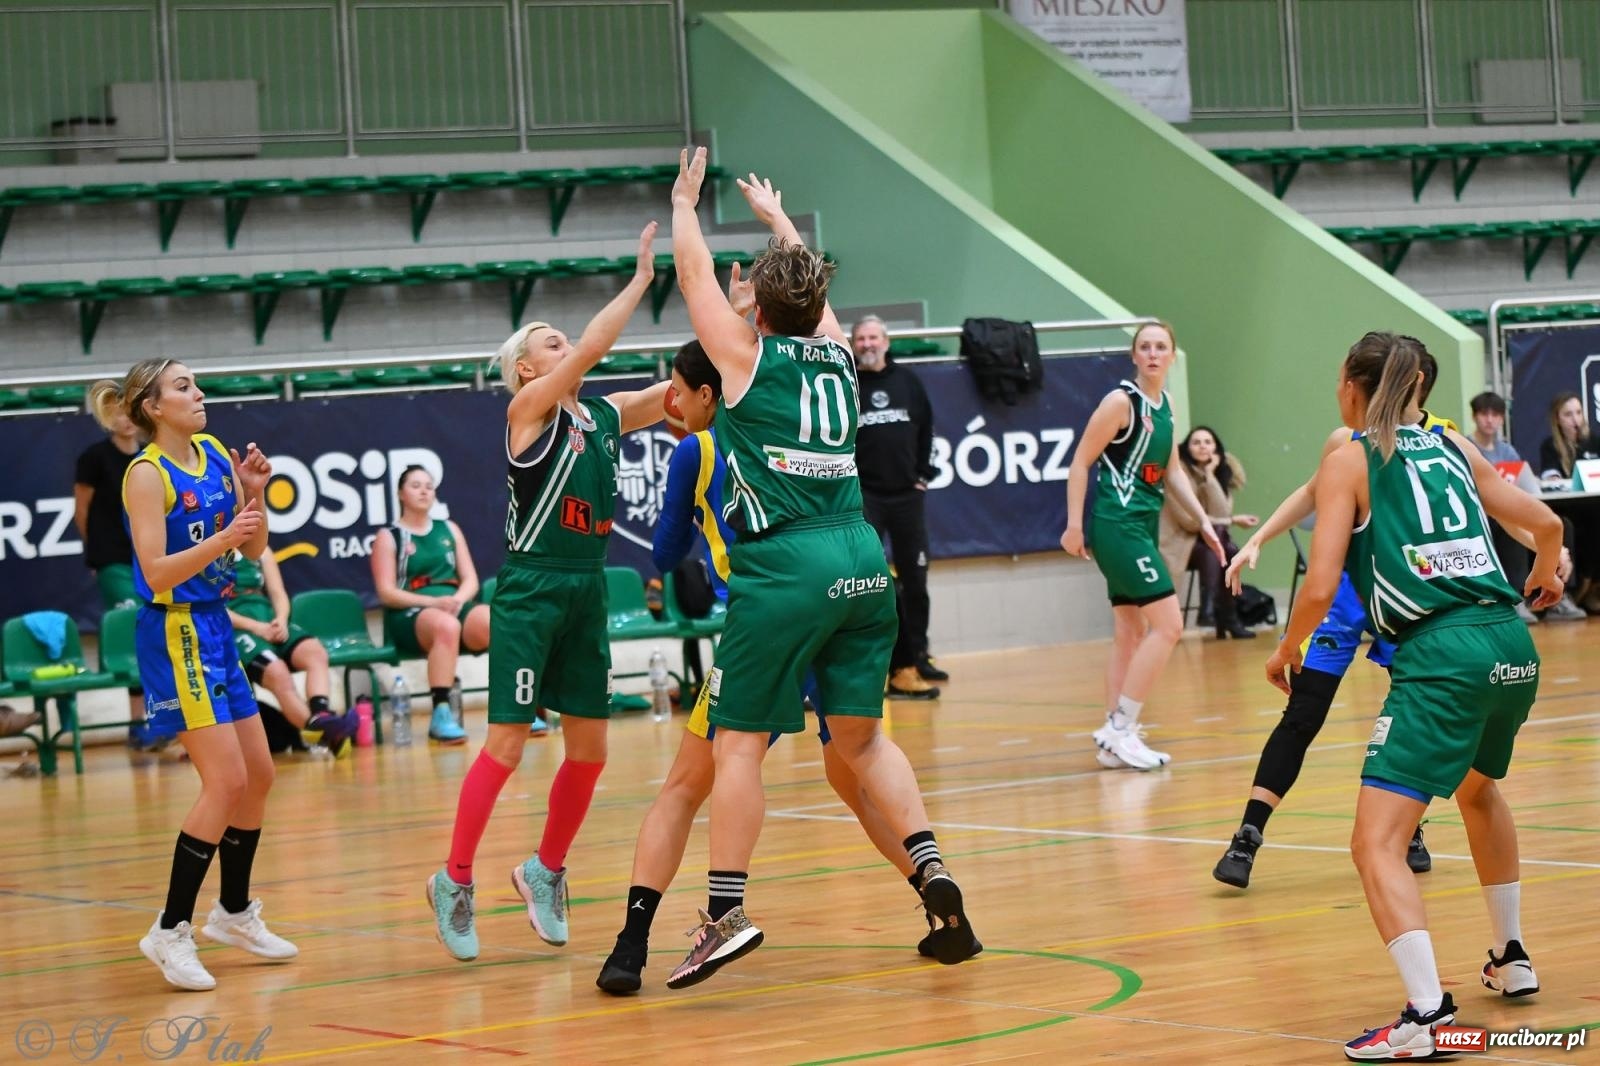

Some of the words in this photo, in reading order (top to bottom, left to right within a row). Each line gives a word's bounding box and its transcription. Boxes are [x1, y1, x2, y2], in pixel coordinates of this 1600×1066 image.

[798, 371, 850, 447] 10
[1404, 455, 1468, 535] 13
[843, 572, 889, 595] Clavis
[1136, 556, 1160, 584] 5
[179, 624, 202, 702] CHROBRY
[1500, 659, 1537, 681] Clavis
[514, 667, 535, 705] 8
